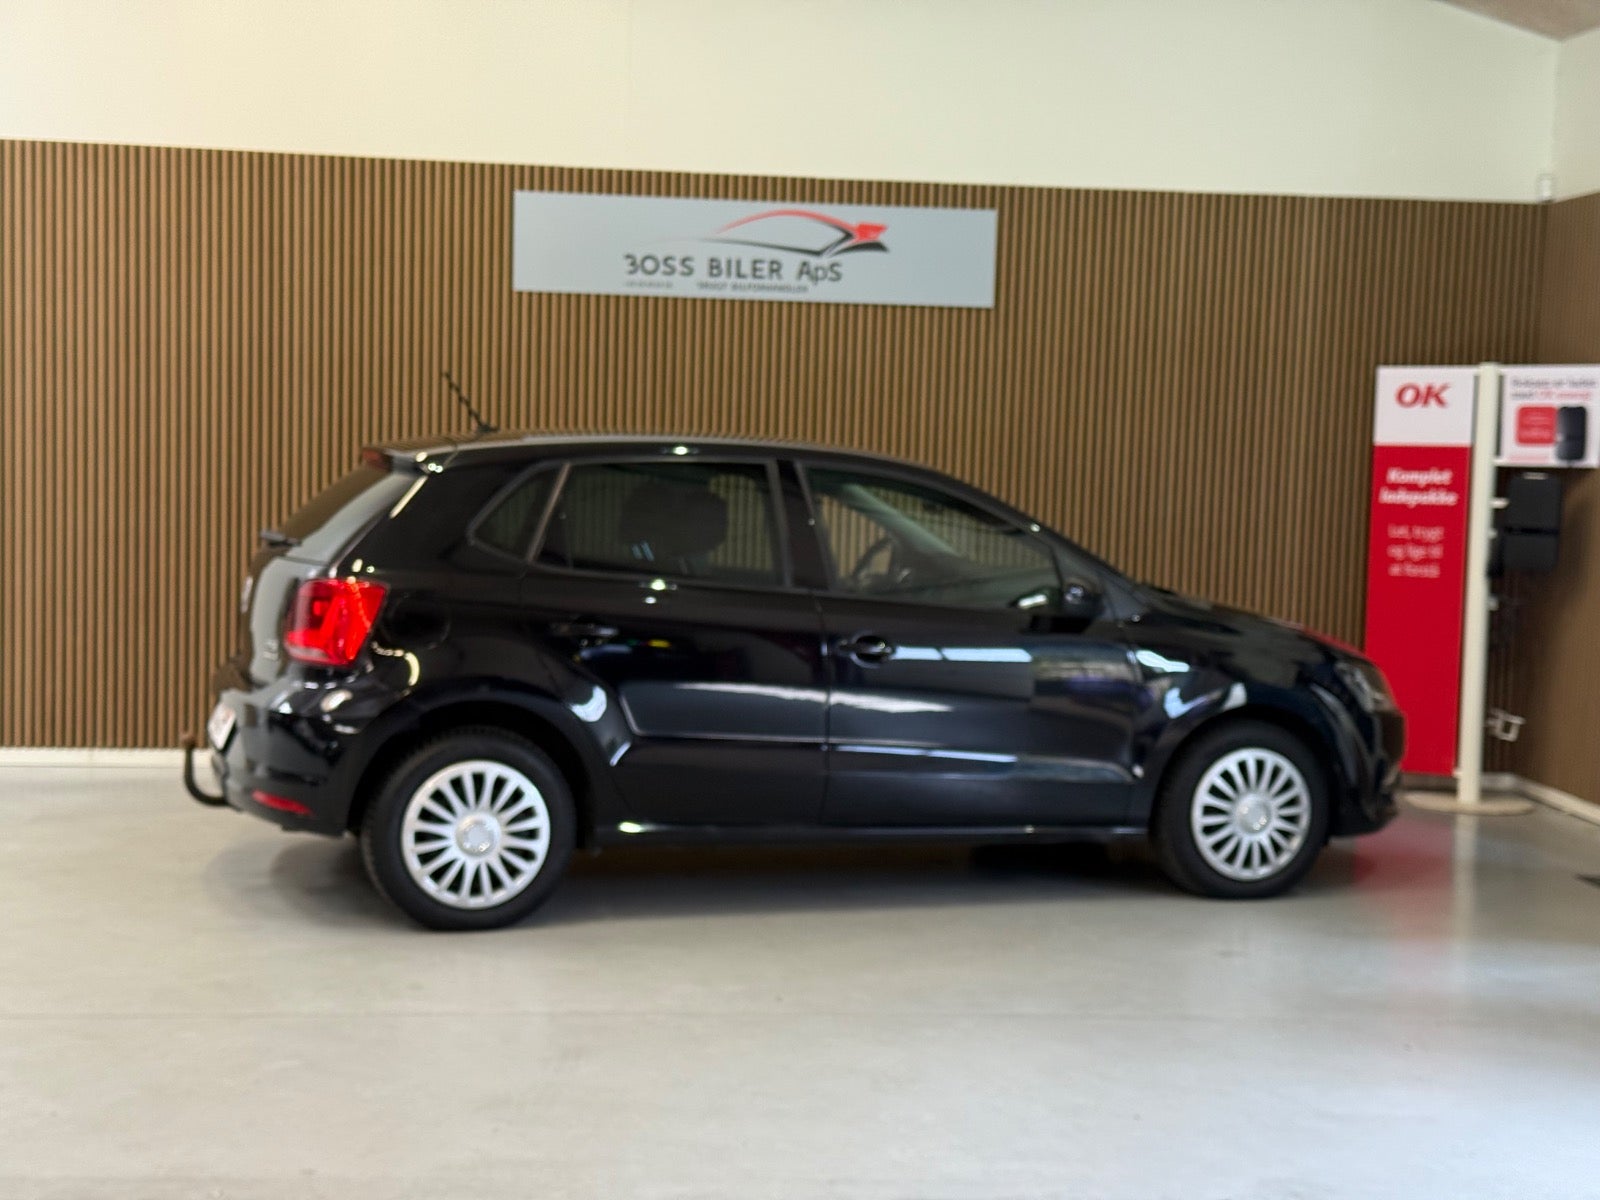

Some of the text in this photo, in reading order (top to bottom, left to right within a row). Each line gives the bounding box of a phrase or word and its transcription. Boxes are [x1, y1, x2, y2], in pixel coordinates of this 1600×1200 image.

[707, 257, 783, 281] BILER
[796, 261, 843, 286] ApS
[1395, 382, 1450, 409] OK
[1386, 466, 1454, 488] Komplet
